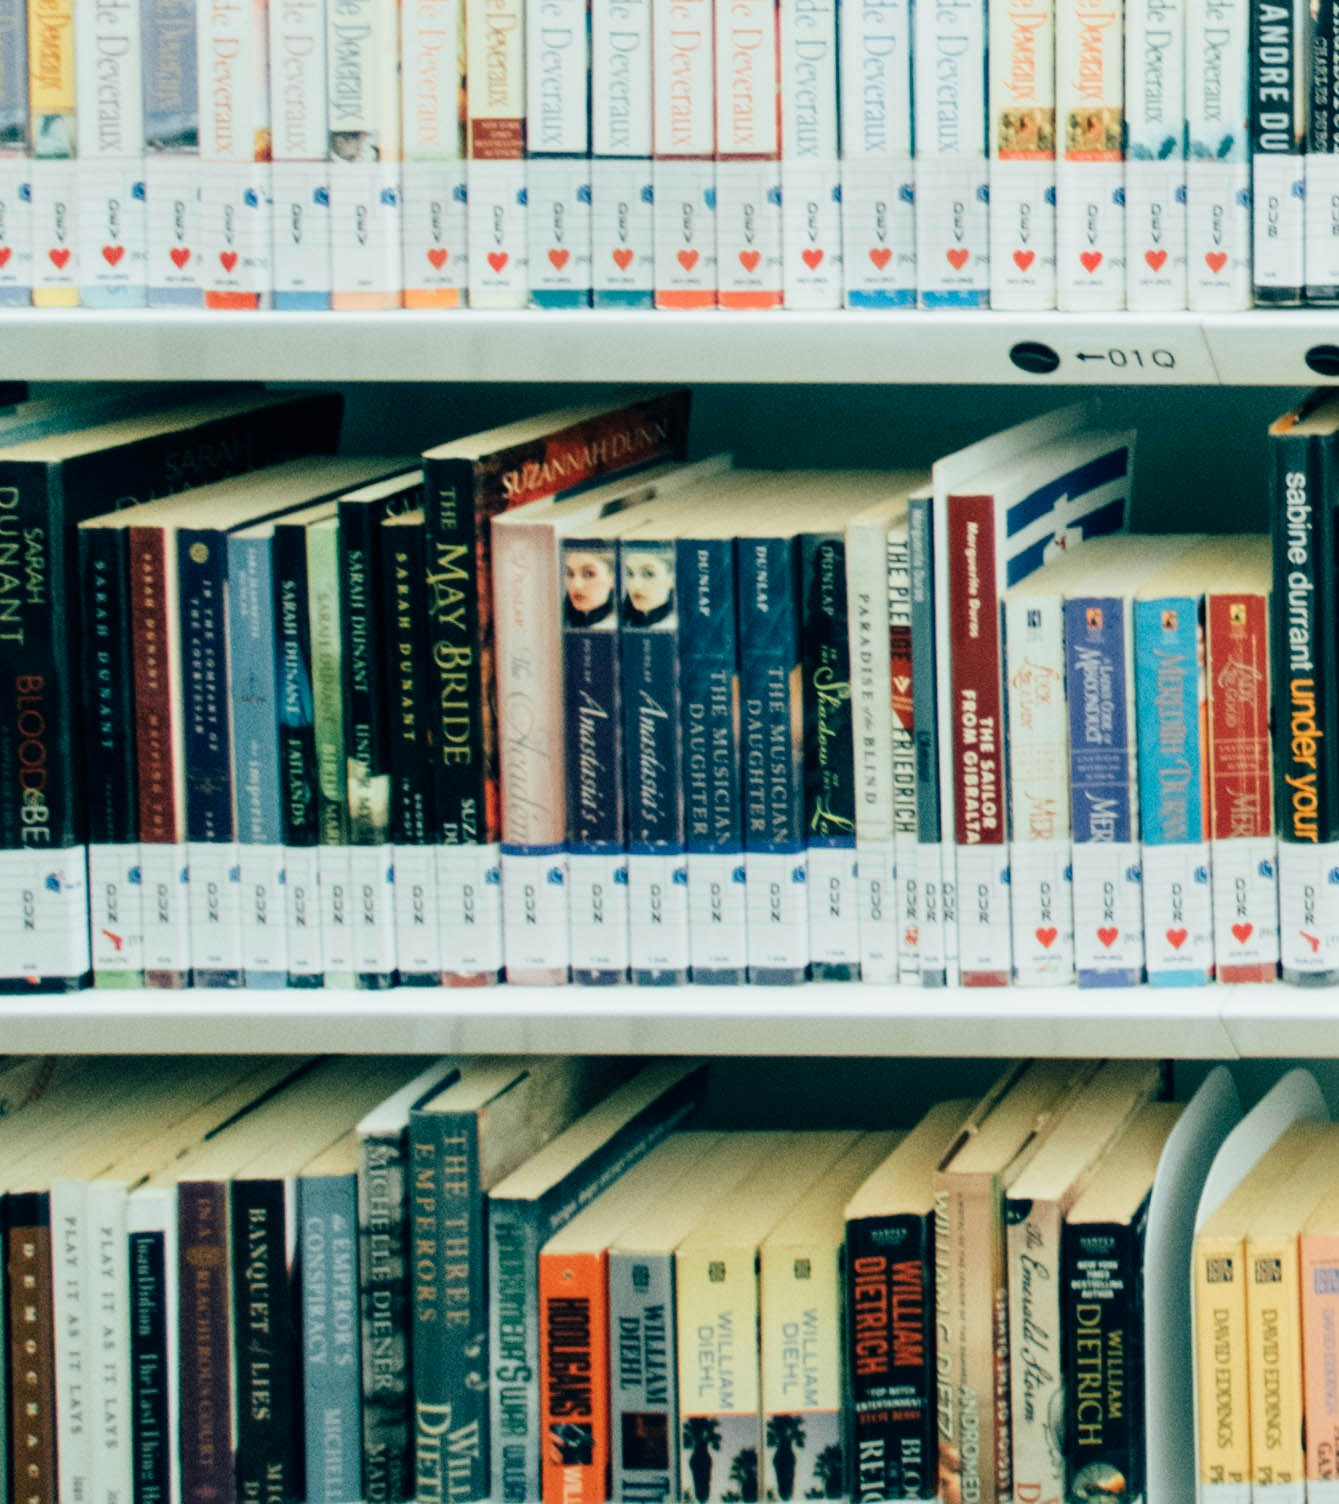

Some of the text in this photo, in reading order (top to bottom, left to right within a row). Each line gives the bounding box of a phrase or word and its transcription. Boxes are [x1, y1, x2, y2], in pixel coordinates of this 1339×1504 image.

[96, 34, 129, 153] Deveraux
[1259, 2, 1290, 103] ANDRE
[1106, 349, 1177, 369] 01Q
[1285, 472, 1306, 565] sabine
[434, 542, 468, 630] MAY
[1286, 571, 1311, 671] durrant
[1288, 677, 1324, 769] under
[248, 1207, 268, 1334] BANQUET
[414, 1142, 435, 1322] EMPERORS
[443, 1135, 470, 1327] THE THREE
[855, 1255, 887, 1375] DIETRICH
[893, 1259, 923, 1367] WILLIAM
